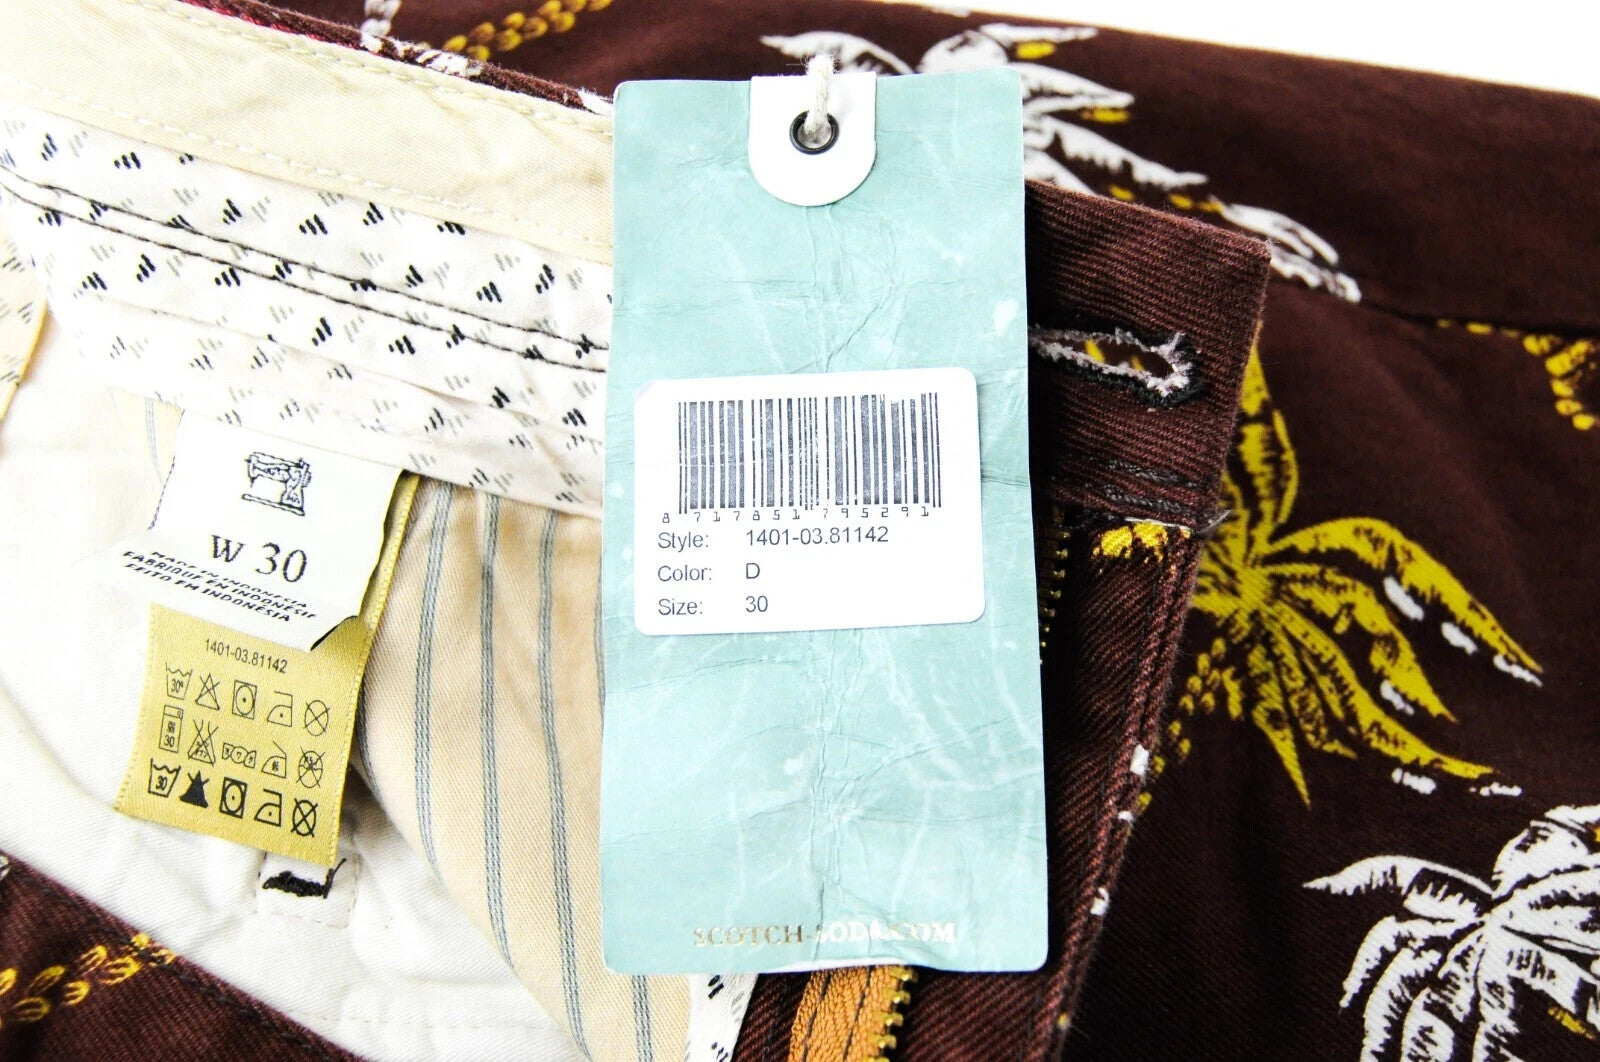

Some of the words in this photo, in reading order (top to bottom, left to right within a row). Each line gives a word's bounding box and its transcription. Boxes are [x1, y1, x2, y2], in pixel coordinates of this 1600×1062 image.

[657, 531, 709, 552] Style:
[746, 526, 889, 546] 1401-03.81142
[211, 534, 245, 563] W
[255, 542, 308, 583] 30
[657, 565, 712, 582] Color:
[746, 562, 761, 580] D
[657, 598, 703, 616] Size:
[746, 595, 768, 613] 30
[205, 638, 288, 674] 1401-03.81142
[156, 774, 168, 791] 30
